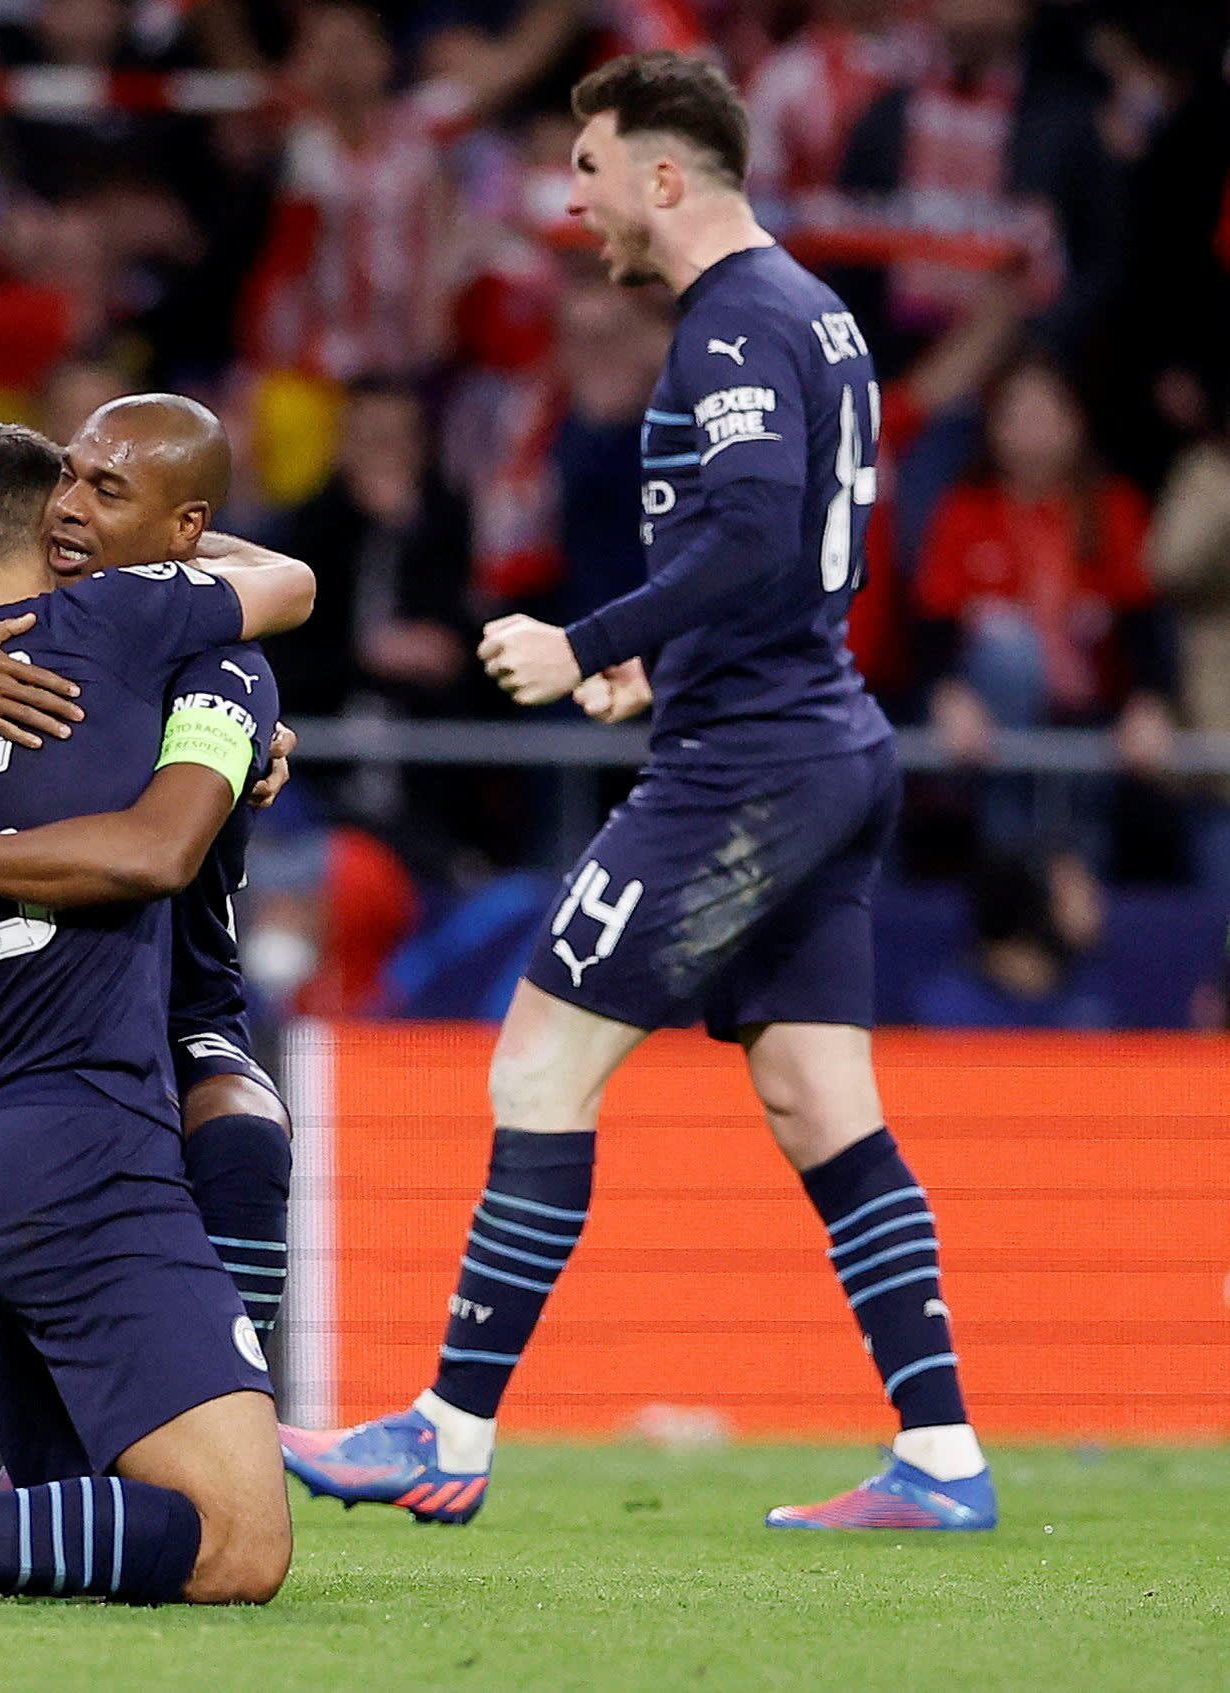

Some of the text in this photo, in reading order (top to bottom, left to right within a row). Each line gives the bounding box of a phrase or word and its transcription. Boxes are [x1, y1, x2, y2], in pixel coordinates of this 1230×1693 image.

[694, 386, 776, 428] NEXEN
[704, 410, 765, 444] TIRE
[172, 692, 258, 740] NEXEN
[551, 858, 645, 960] 14
